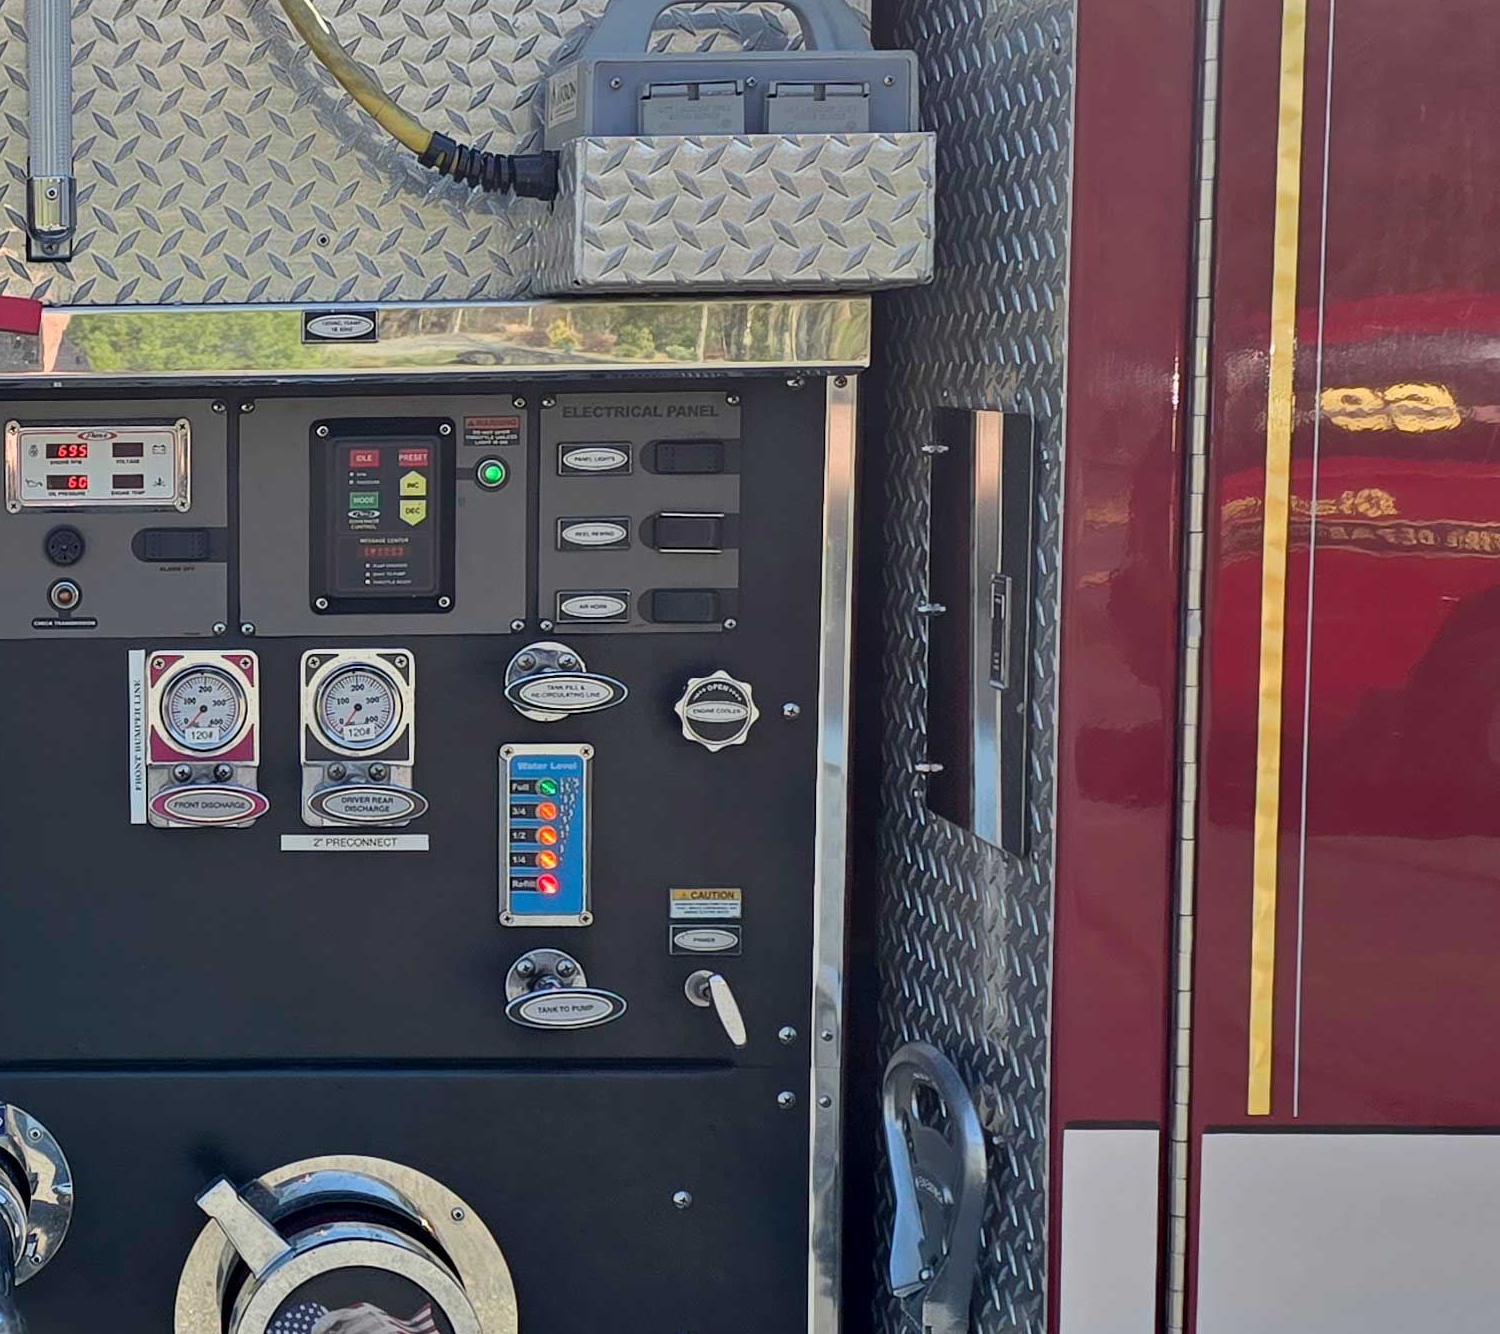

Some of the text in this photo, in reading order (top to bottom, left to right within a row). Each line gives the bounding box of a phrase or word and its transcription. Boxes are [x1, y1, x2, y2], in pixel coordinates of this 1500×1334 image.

[563, 406, 720, 419] ELECTRICAL PANEL
[58, 445, 88, 458] 695
[356, 454, 373, 462] IDLE
[351, 684, 365, 692] 200
[706, 683, 731, 692] OPEN
[212, 699, 226, 707] 300
[337, 697, 350, 705] 100
[366, 696, 380, 705] 300
[191, 731, 214, 740] 120#
[348, 727, 371, 738] 120#
[517, 762, 578, 771] Water Level
[345, 805, 390, 813] DISCHARGE
[512, 807, 526, 816] 3/4
[512, 832, 526, 840] 1/2
[326, 838, 398, 848] PRECONNECT
[512, 856, 526, 864] 1/4
[691, 891, 734, 899] CAUTION
